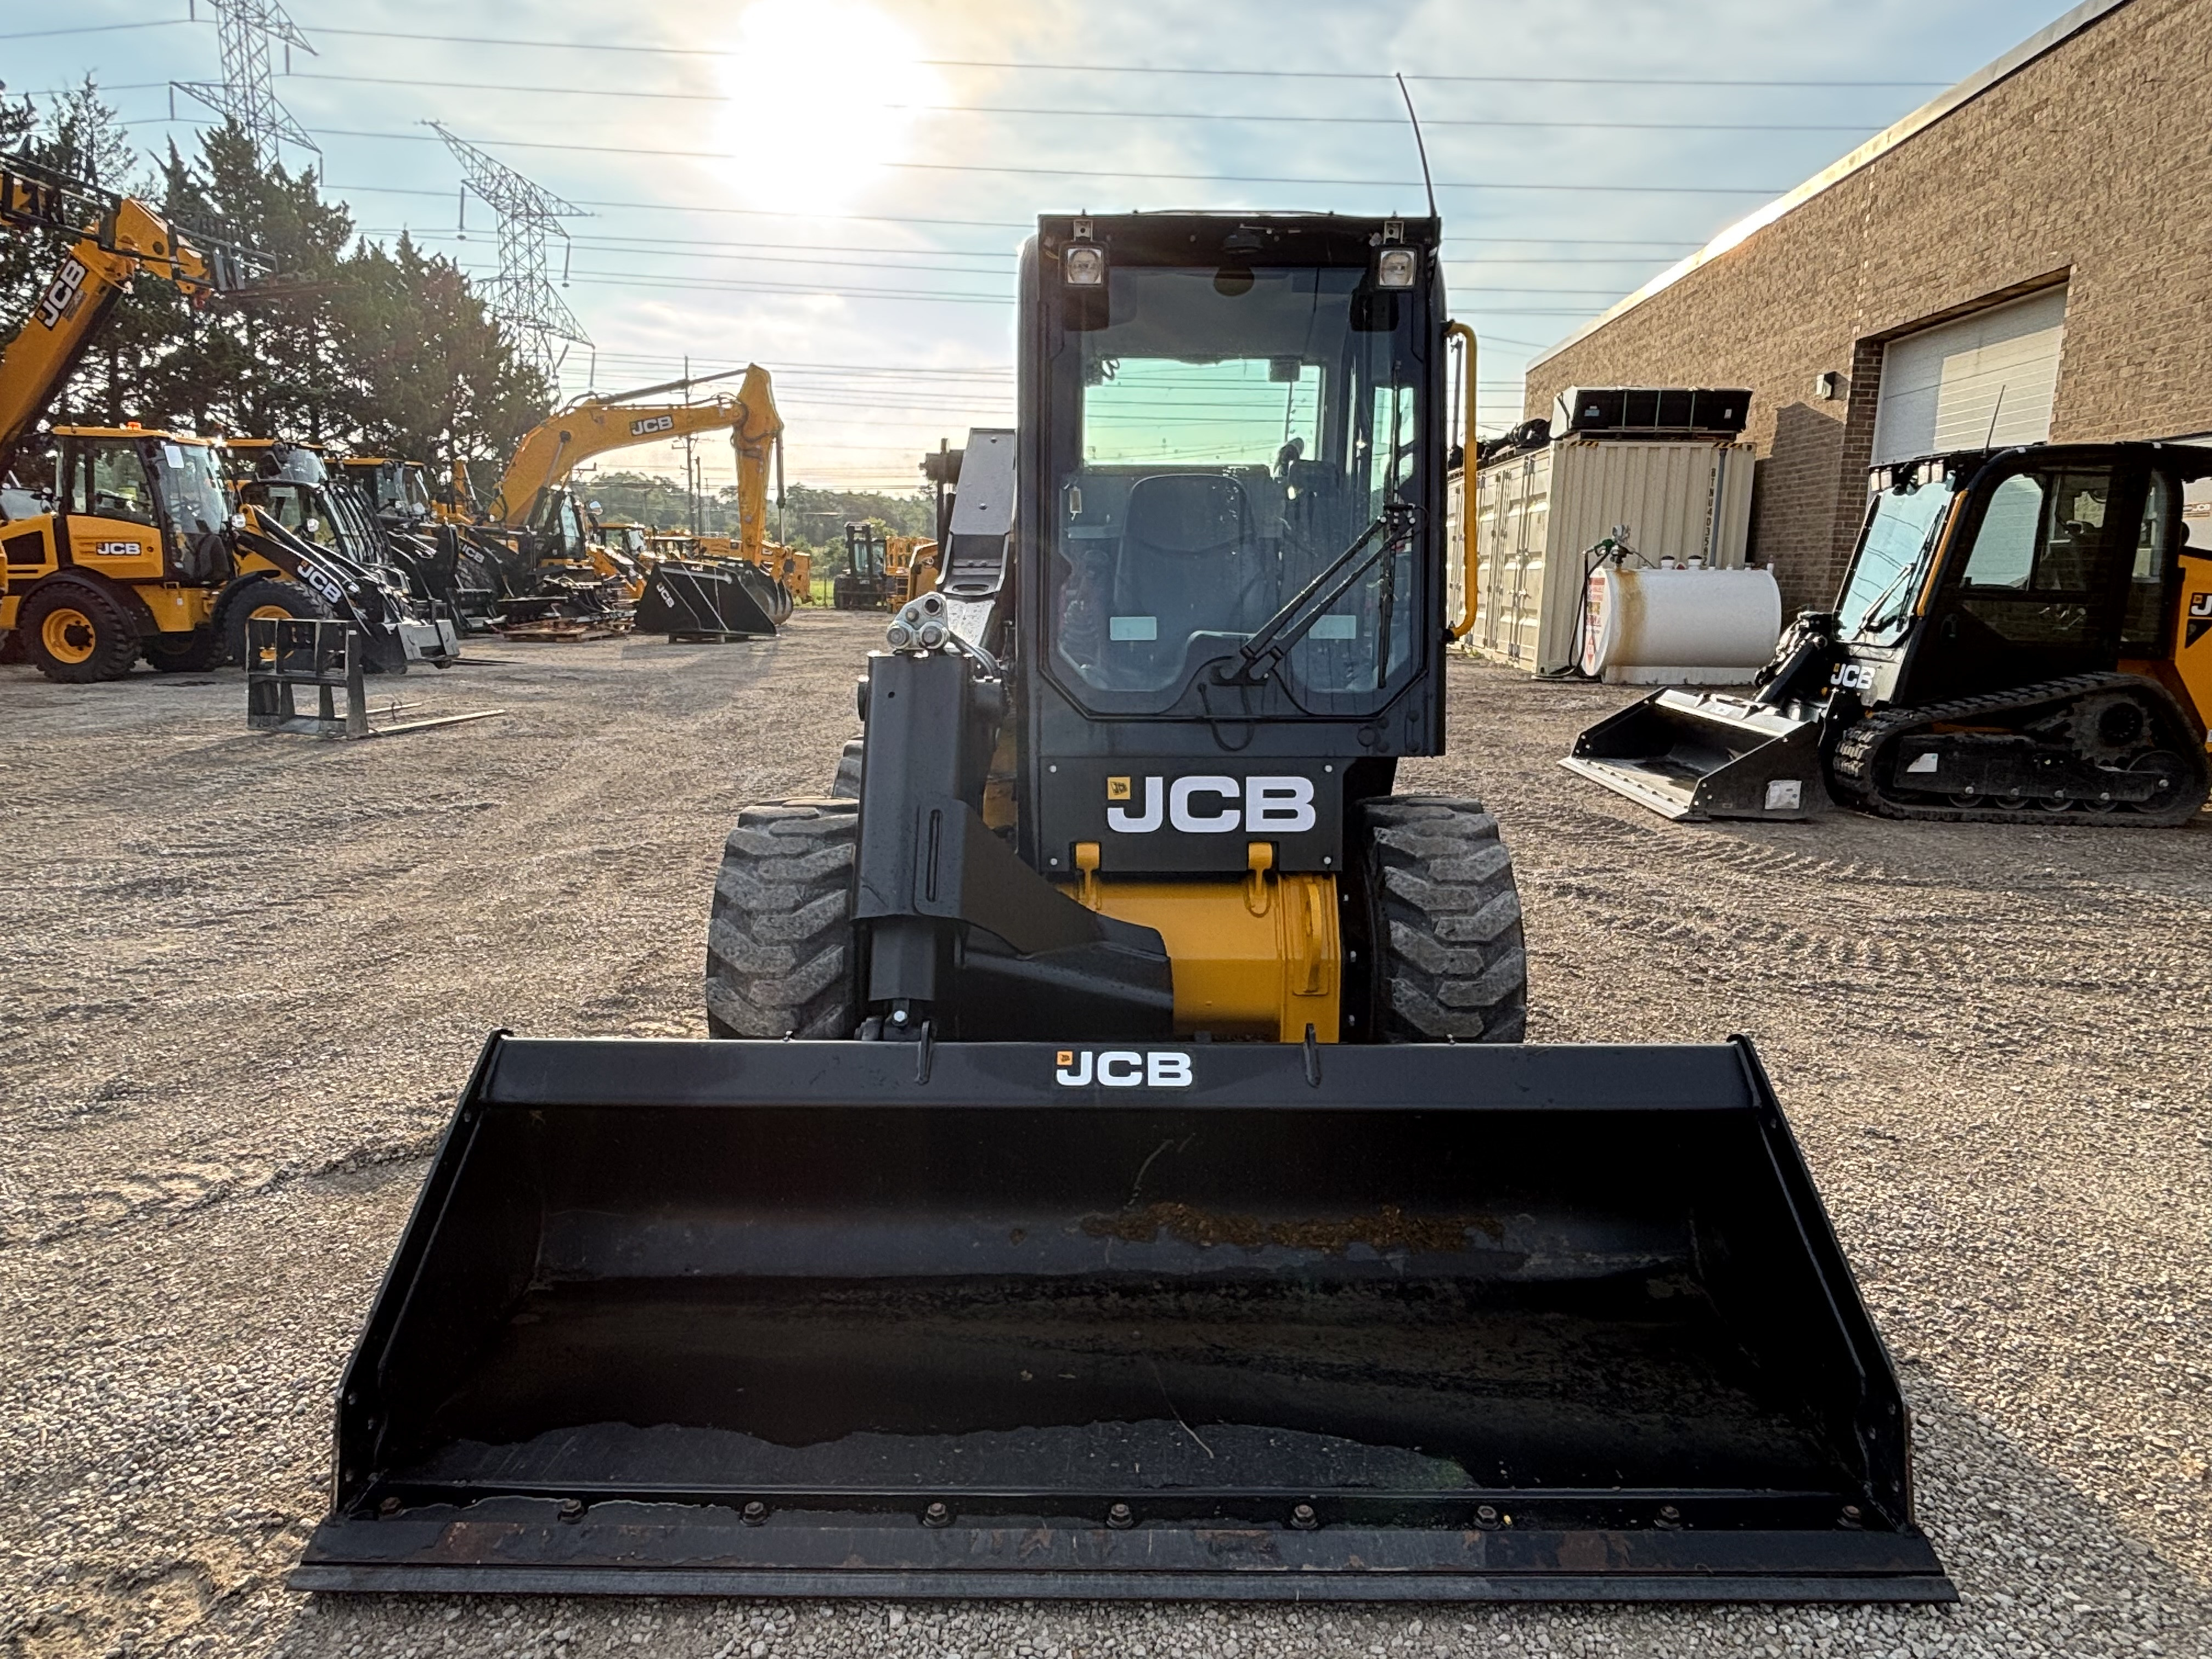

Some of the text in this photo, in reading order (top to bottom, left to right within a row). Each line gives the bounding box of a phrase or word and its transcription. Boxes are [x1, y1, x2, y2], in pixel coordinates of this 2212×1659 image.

[41, 260, 85, 327] JCB
[632, 416, 673, 435] JCB
[97, 543, 140, 554] JCB
[297, 560, 341, 603] JCB
[656, 582, 675, 608] JCB
[1830, 663, 1876, 689] JCB
[1107, 776, 1316, 833] JCB
[1057, 1051, 1193, 1086] JCB
